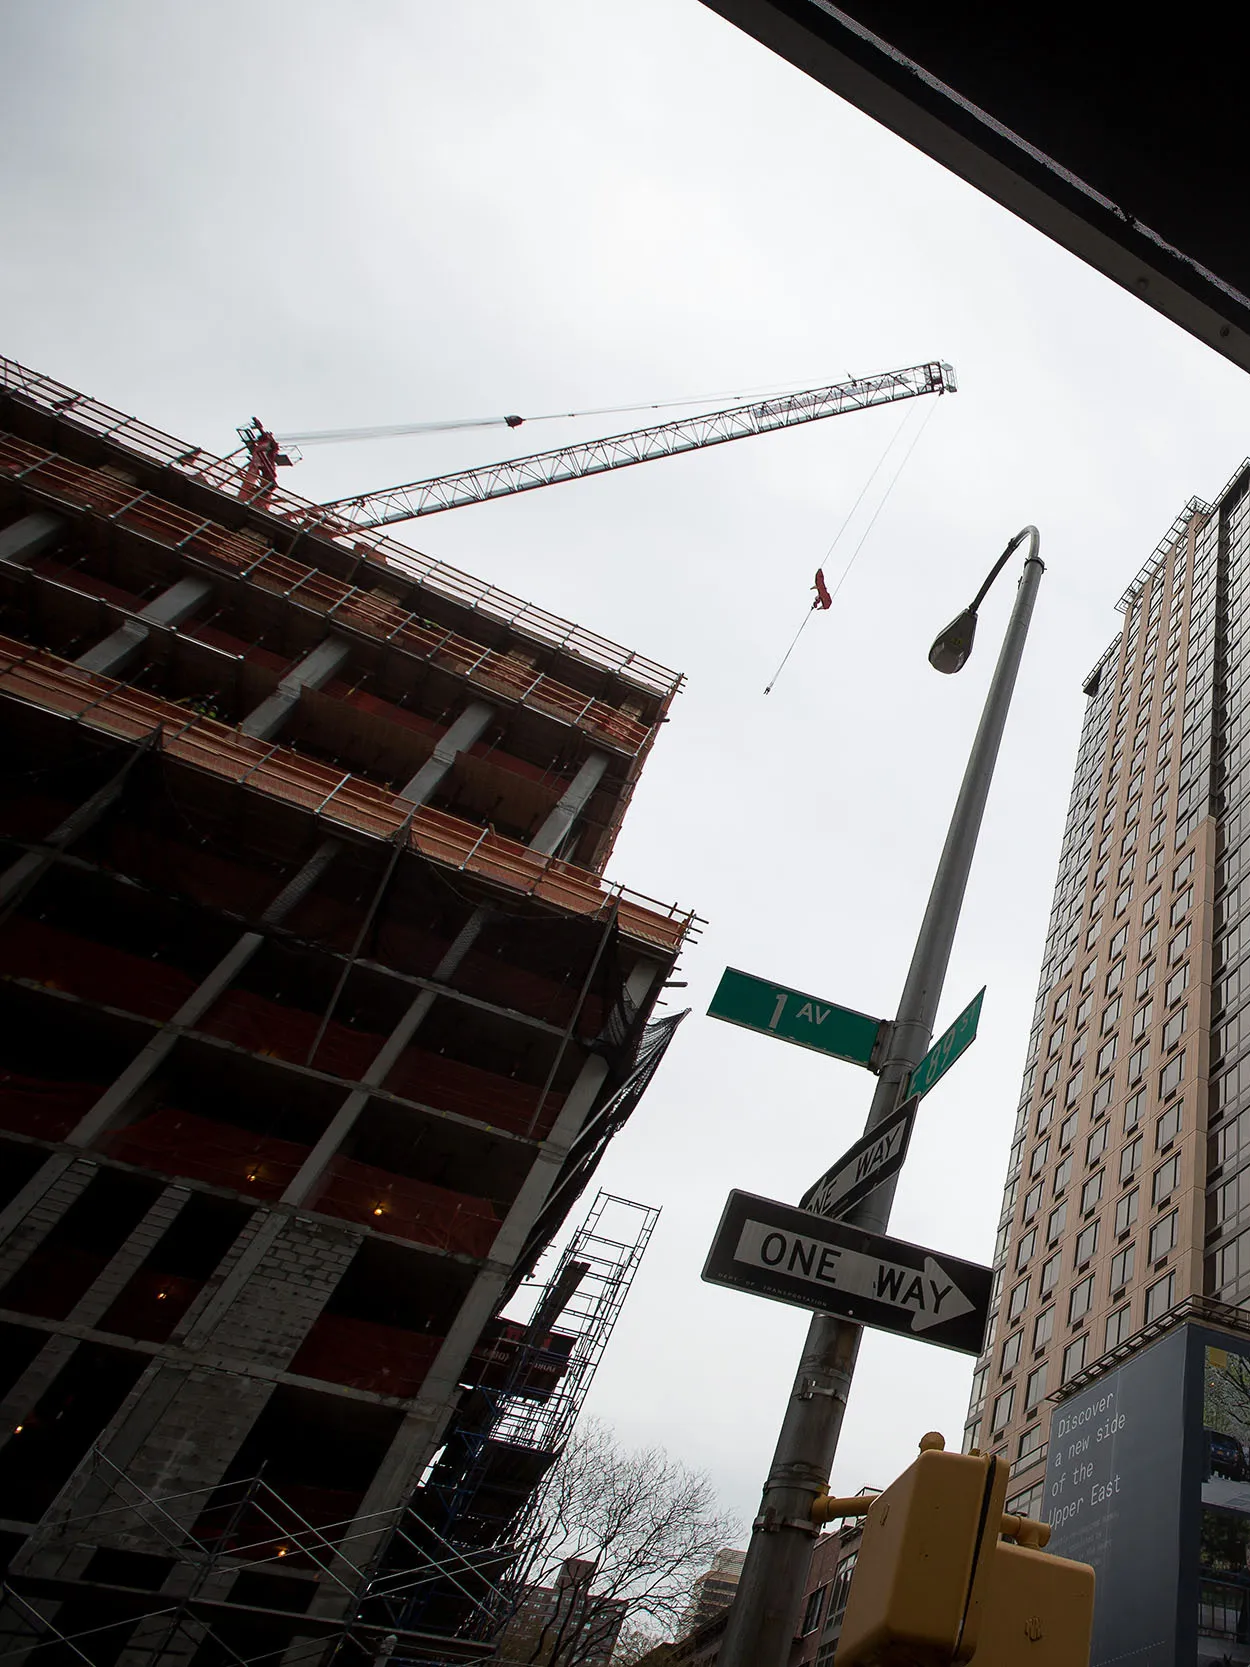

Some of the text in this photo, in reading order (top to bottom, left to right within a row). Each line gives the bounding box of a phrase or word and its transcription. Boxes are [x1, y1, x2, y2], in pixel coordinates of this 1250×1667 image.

[769, 993, 831, 1029] 1 AV
[925, 1027, 956, 1085] 89
[855, 1126, 901, 1182] WAY
[760, 1232, 953, 1314] ONE WAY
[1054, 1413, 1127, 1468] a new side
[1057, 1392, 1115, 1439] Discover
[1048, 1474, 1122, 1530] Upper East
[1051, 1461, 1094, 1497] of the
